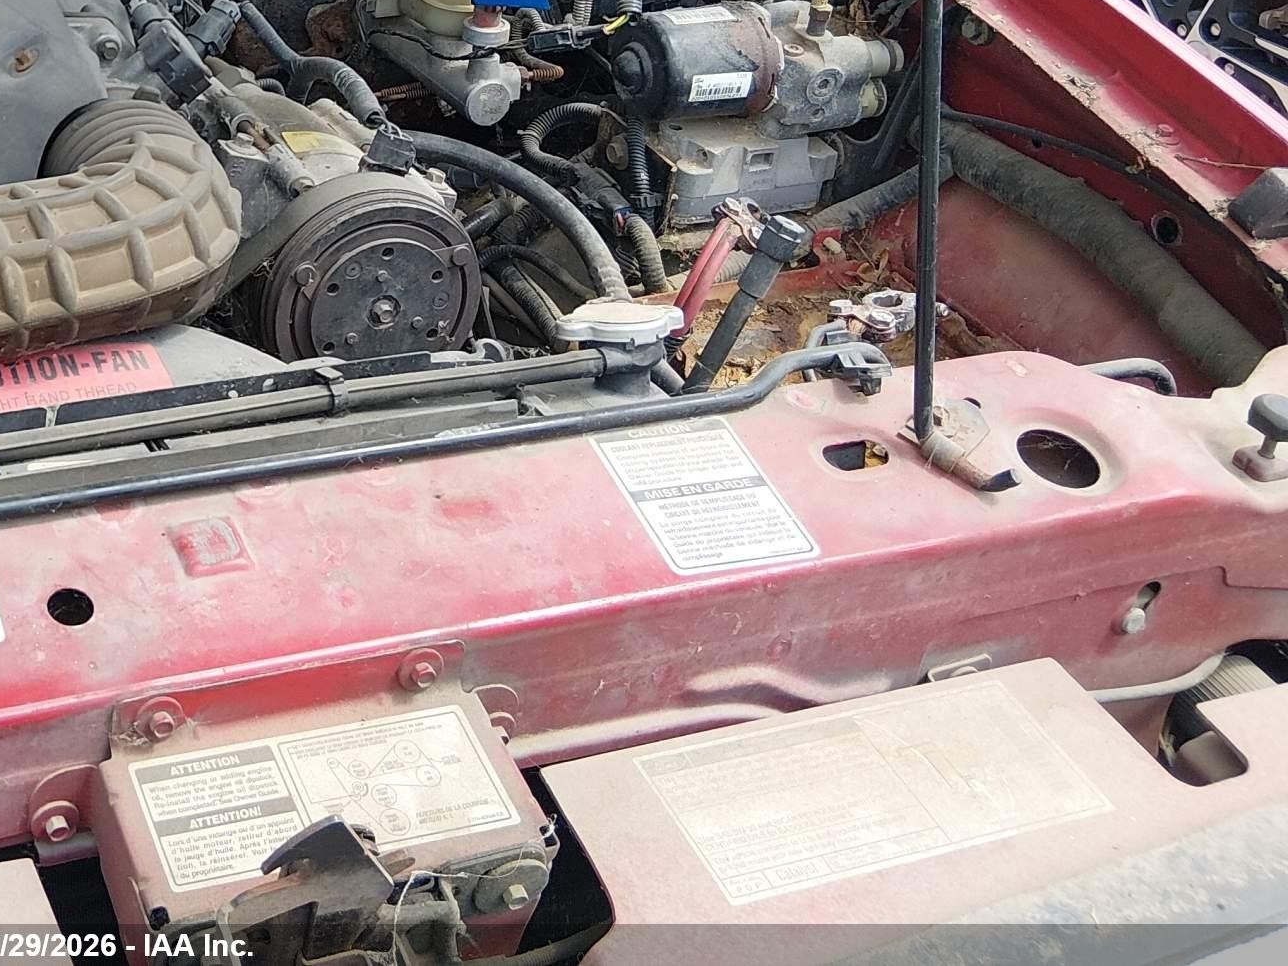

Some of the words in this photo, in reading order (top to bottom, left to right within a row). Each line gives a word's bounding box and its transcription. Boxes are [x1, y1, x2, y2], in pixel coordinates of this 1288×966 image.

[24, 388, 72, 408] HAND
[74, 381, 138, 401] THREAD
[626, 424, 692, 439] CAUTION
[644, 488, 681, 501] MISE
[701, 478, 753, 493] GARDE
[167, 753, 241, 776] ATTENTION
[147, 783, 171, 794] When
[171, 776, 208, 790] changing
[219, 769, 247, 781] adding
[245, 765, 273, 777] engine
[163, 787, 192, 799] remove
[192, 785, 206, 794] the
[206, 780, 234, 791] engine
[232, 778, 244, 787] oil
[152, 795, 191, 809] Re-install
[191, 792, 206, 802] the
[205, 787, 235, 799] engine
[234, 785, 247, 794] oil
[246, 779, 278, 792] dipstick
[155, 806, 178, 816] when
[231, 791, 257, 802] Owner
[186, 804, 263, 829] ATTENTION!
[166, 837, 185, 847] Lors
[182, 833, 208, 844] d'une
[206, 827, 238, 840] vidange
[247, 821, 267, 832] d'un
[265, 816, 296, 829] appoint
[168, 842, 201, 855] d'huile
[200, 835, 235, 848] moteur,
[235, 829, 264, 842] retirer
[264, 823, 298, 836] d'abord
[181, 850, 205, 861] jauge
[237, 839, 262, 851] Après
[250, 846, 269, 857] Voir
